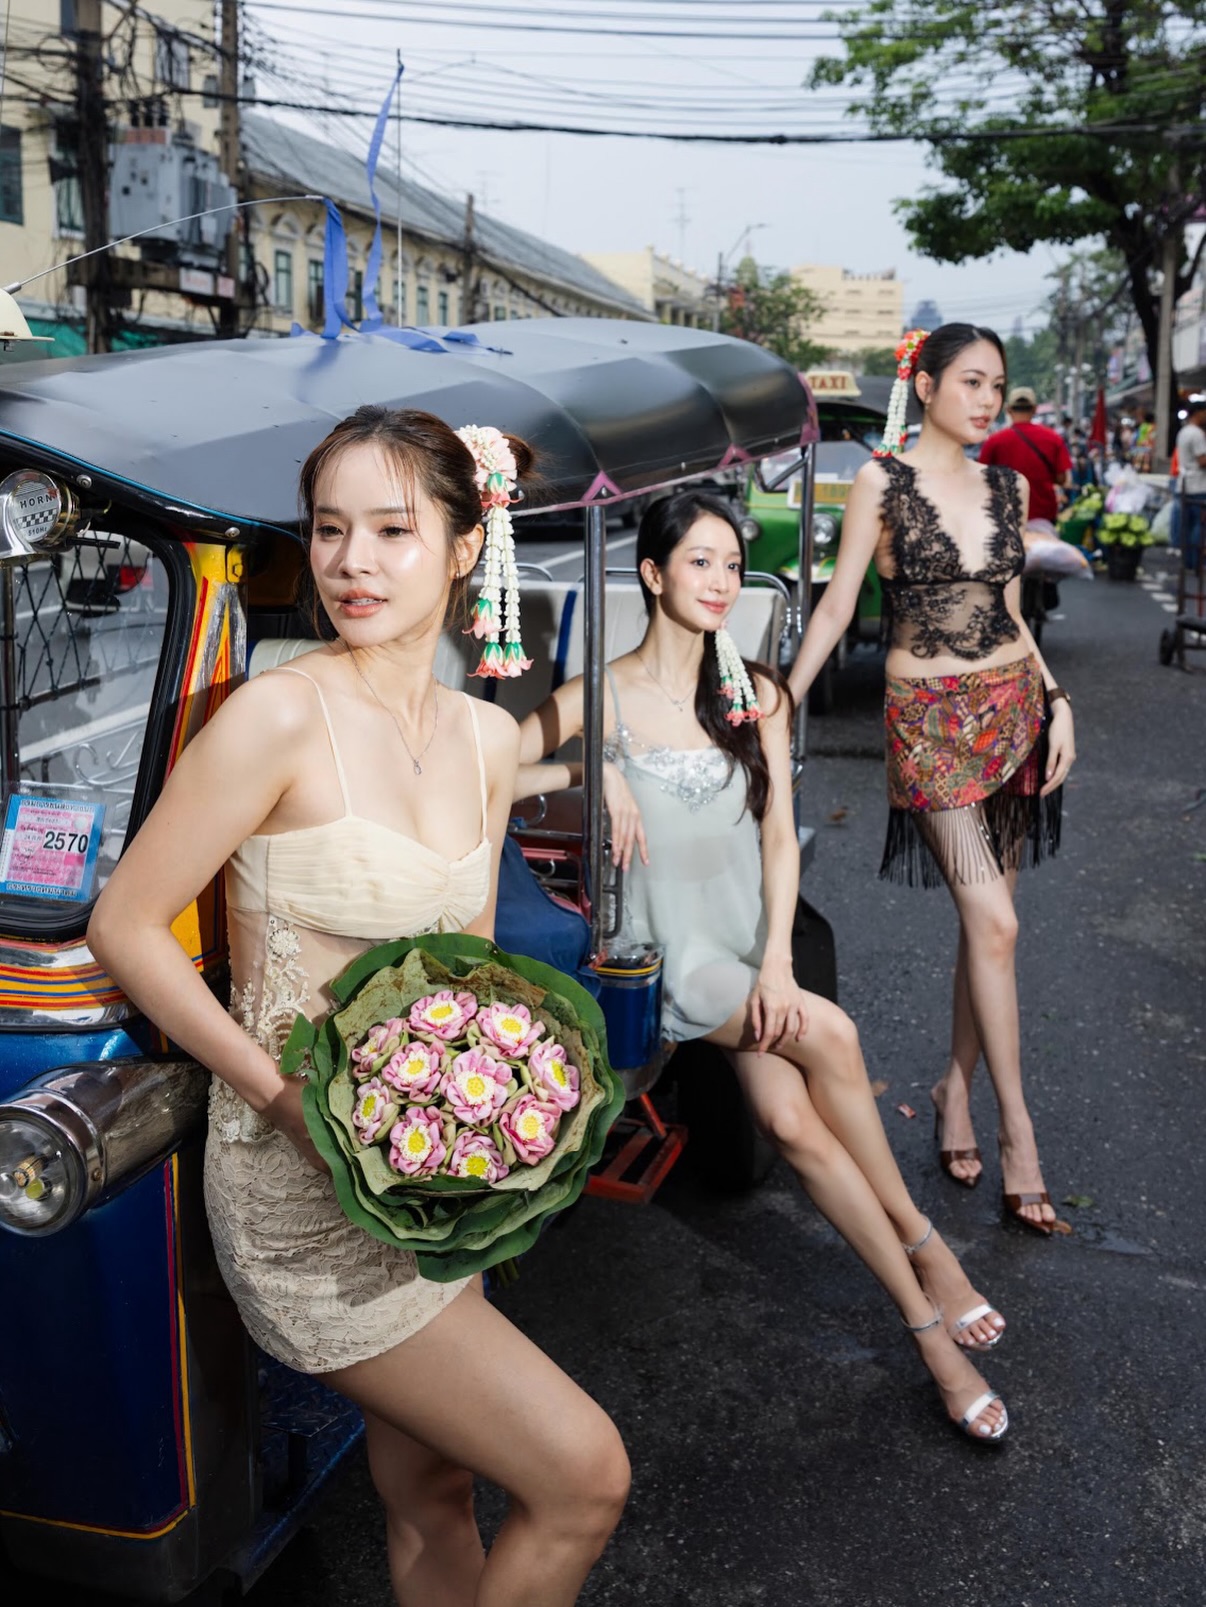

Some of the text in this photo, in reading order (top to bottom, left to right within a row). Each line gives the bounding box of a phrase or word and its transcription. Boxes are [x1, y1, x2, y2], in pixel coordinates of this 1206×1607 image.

[809, 375, 846, 390] TAXI
[20, 494, 53, 509] HORN
[43, 830, 89, 854] 2570
